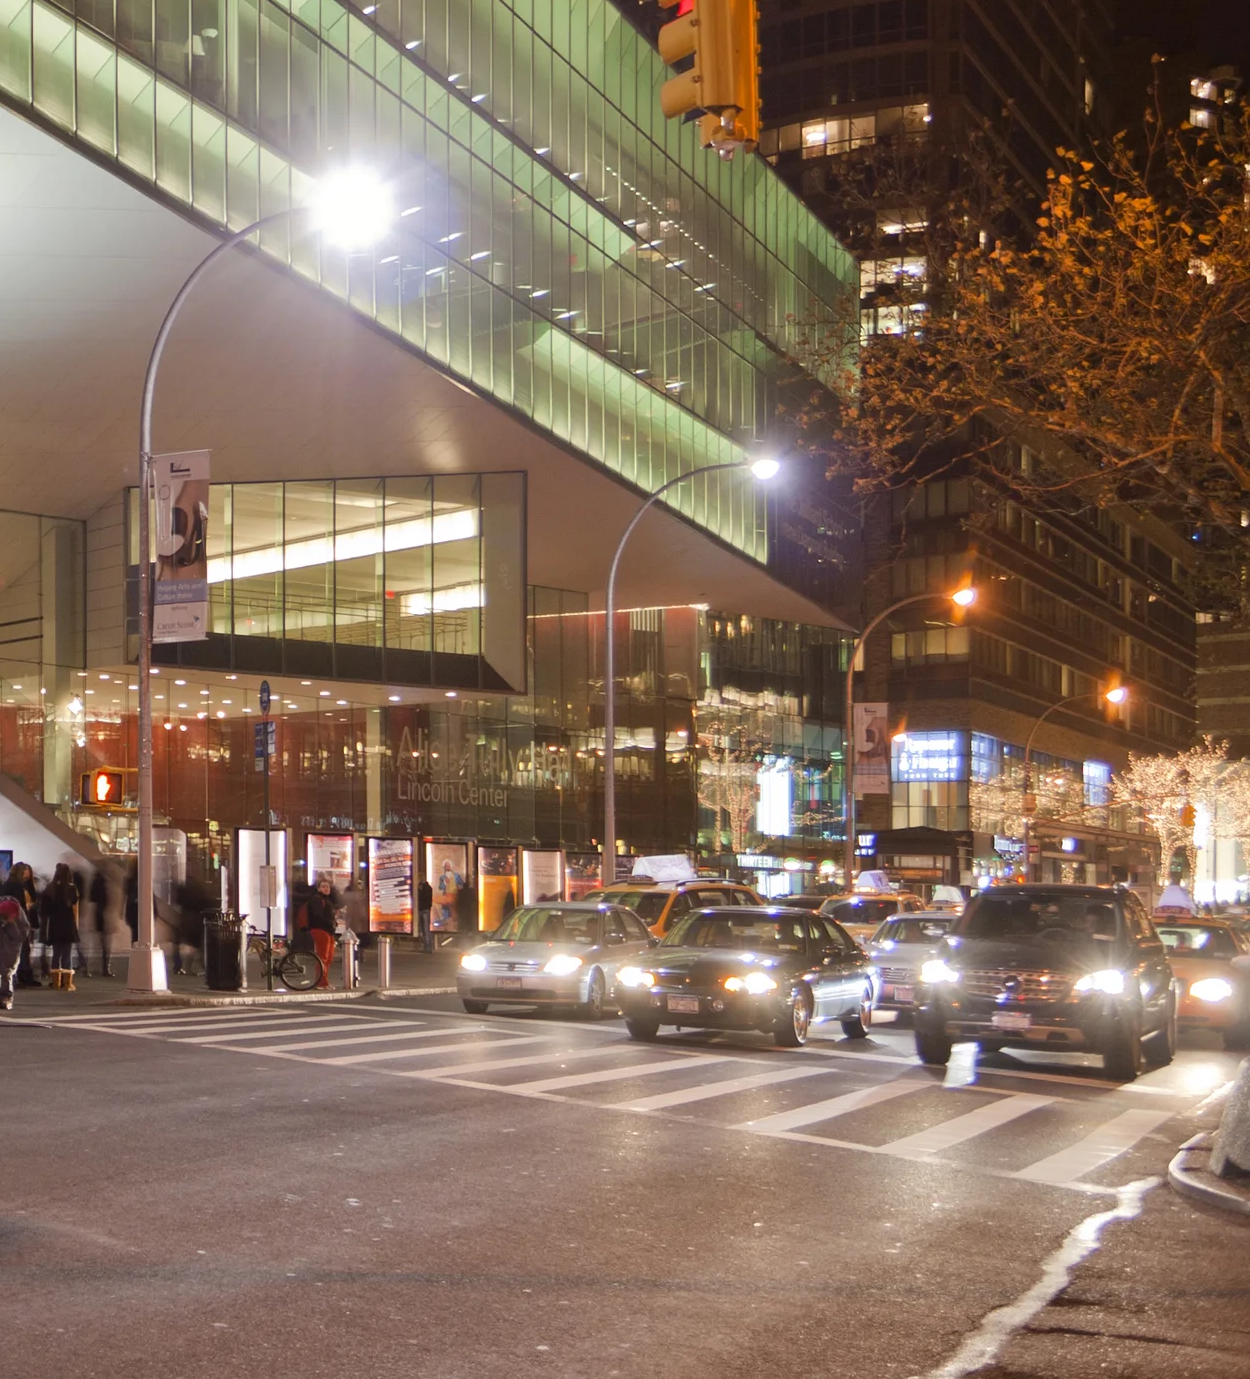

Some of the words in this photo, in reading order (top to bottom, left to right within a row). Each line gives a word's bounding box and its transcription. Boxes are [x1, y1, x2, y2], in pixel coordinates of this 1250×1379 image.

[397, 726, 456, 773] Alice
[466, 733, 523, 787] Tully
[531, 740, 577, 791] Hall
[398, 772, 455, 804] Lincoln
[459, 779, 508, 808] Center
[736, 854, 773, 868] THIRTEEN
